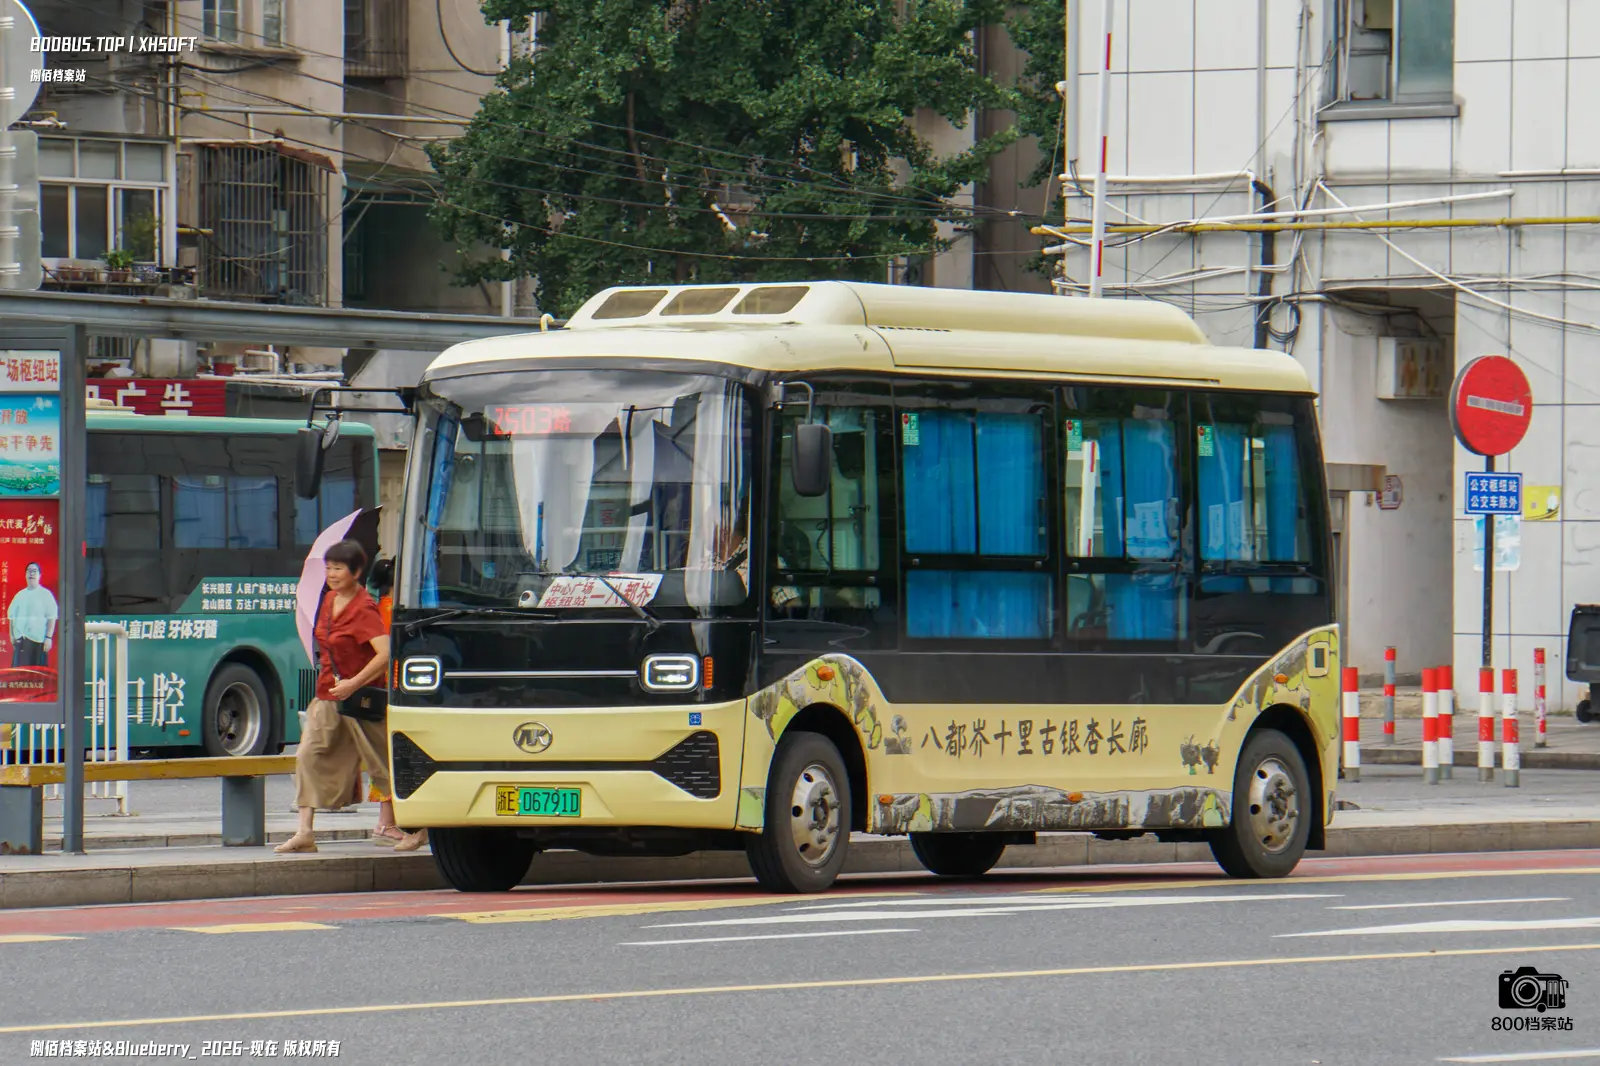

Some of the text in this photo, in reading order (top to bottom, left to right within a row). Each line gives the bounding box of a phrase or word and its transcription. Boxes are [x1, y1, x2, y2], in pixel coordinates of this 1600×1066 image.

[1470, 479, 1518, 492] 公交枢纽站
[1470, 495, 1518, 509] 公交车除外
[202, 583, 232, 594] 长兴院区
[550, 582, 594, 597] 中心广场
[544, 596, 587, 607] 枢纽站
[168, 619, 218, 639] 牙体牙髓
[920, 717, 1148, 759] 八都岕十里古银杏长廊
